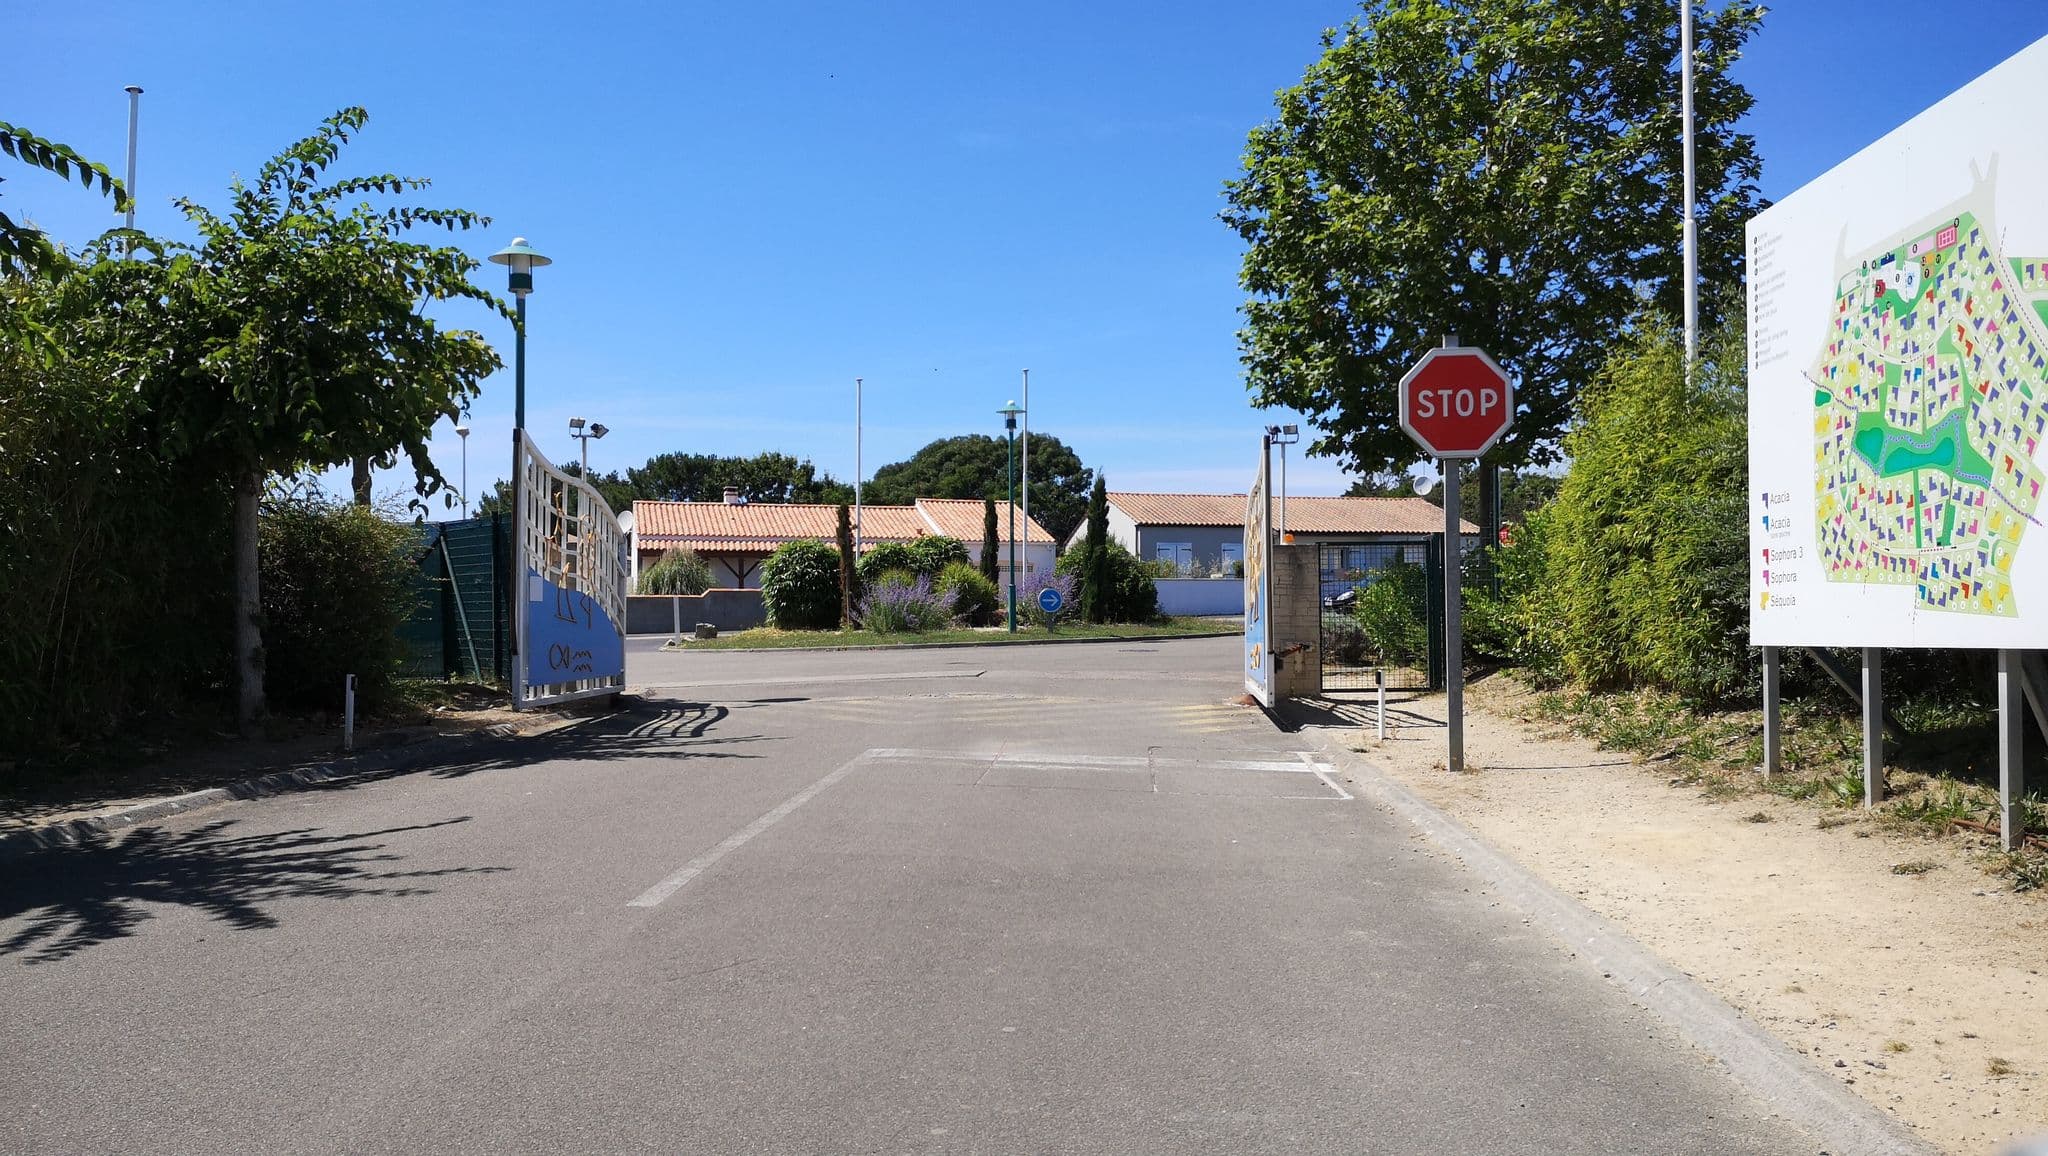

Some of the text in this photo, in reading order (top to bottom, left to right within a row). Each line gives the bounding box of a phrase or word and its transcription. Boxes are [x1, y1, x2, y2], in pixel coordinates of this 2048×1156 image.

[1417, 388, 1498, 418] STOP
[1770, 492, 1790, 504] Acacia
[1770, 516, 1791, 529] Acacia
[1771, 545, 1804, 562] Sophora 3
[1771, 570, 1797, 584] Sophora
